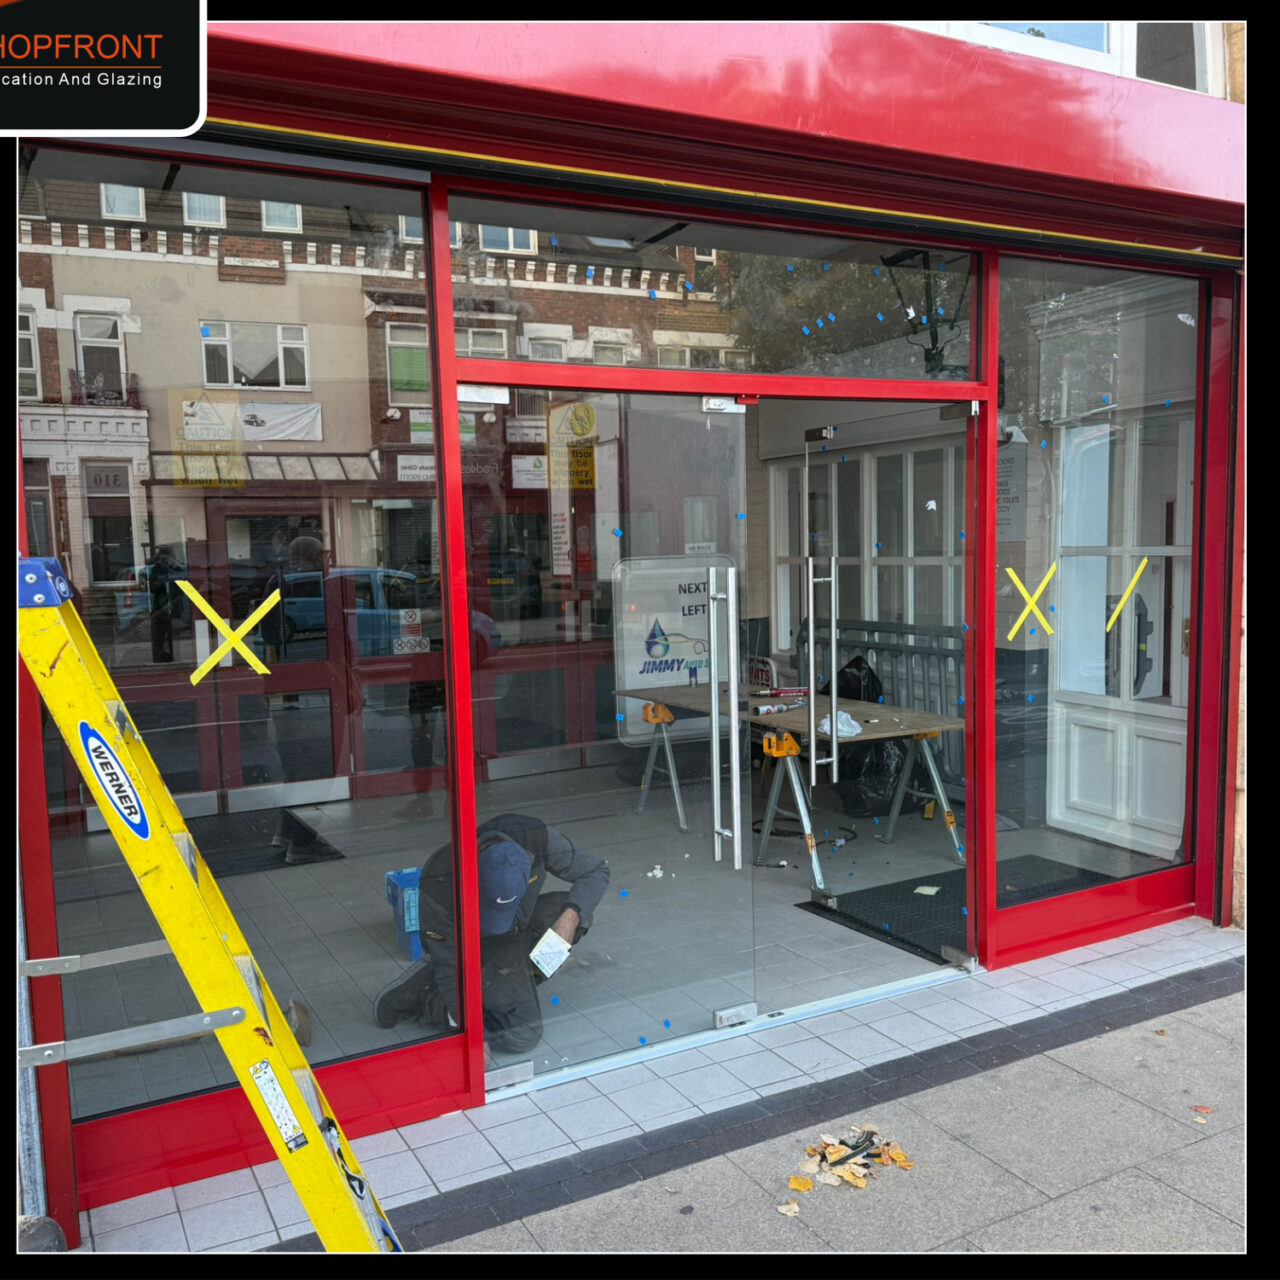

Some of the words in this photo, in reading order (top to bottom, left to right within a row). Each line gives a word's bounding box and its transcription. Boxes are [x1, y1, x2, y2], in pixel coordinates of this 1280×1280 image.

[678, 582, 708, 595] NEXT
[682, 604, 707, 616] LEFT
[639, 658, 685, 674] JIMMY
[91, 745, 139, 817] WERNER
